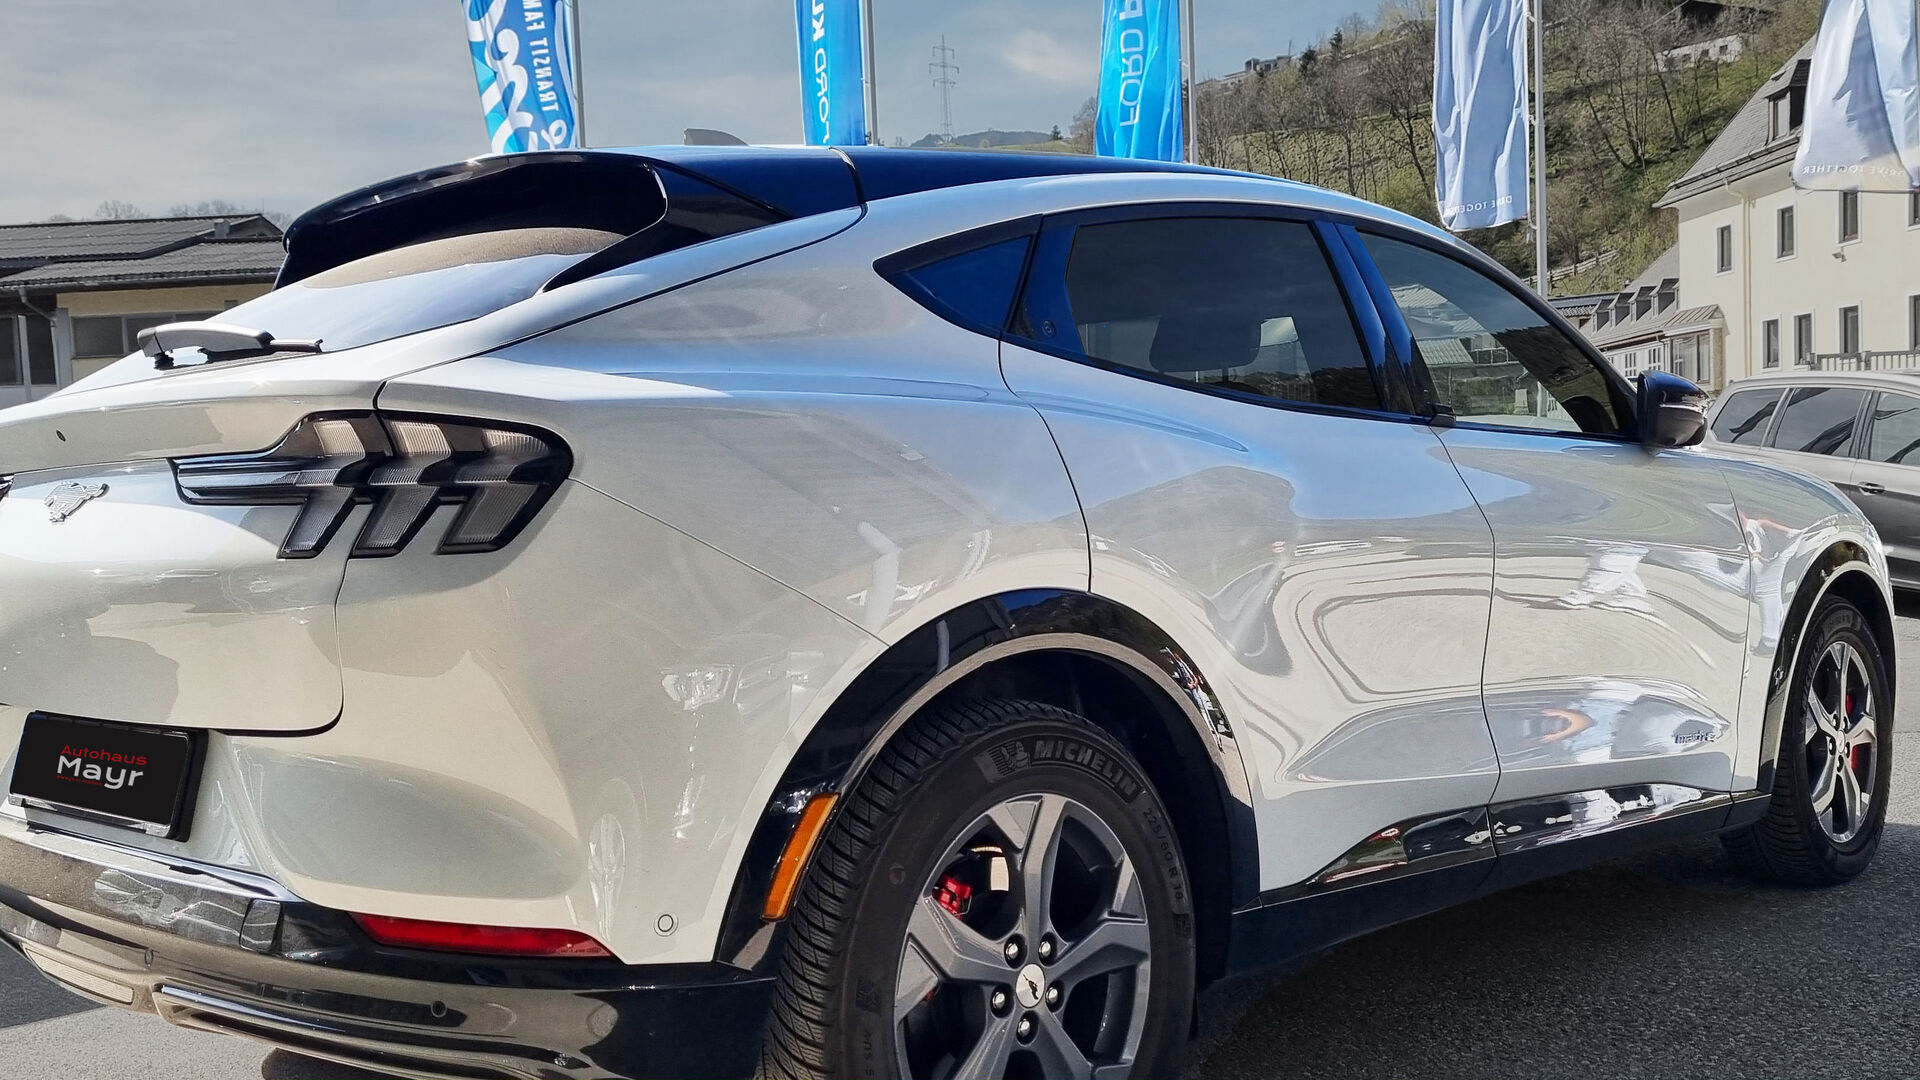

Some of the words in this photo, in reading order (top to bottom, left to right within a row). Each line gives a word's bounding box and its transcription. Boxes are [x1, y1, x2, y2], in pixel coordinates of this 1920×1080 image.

[56, 755, 144, 790] Mayr
[60, 744, 148, 766] Autohaus
[1033, 739, 1137, 796] MICHELIN
